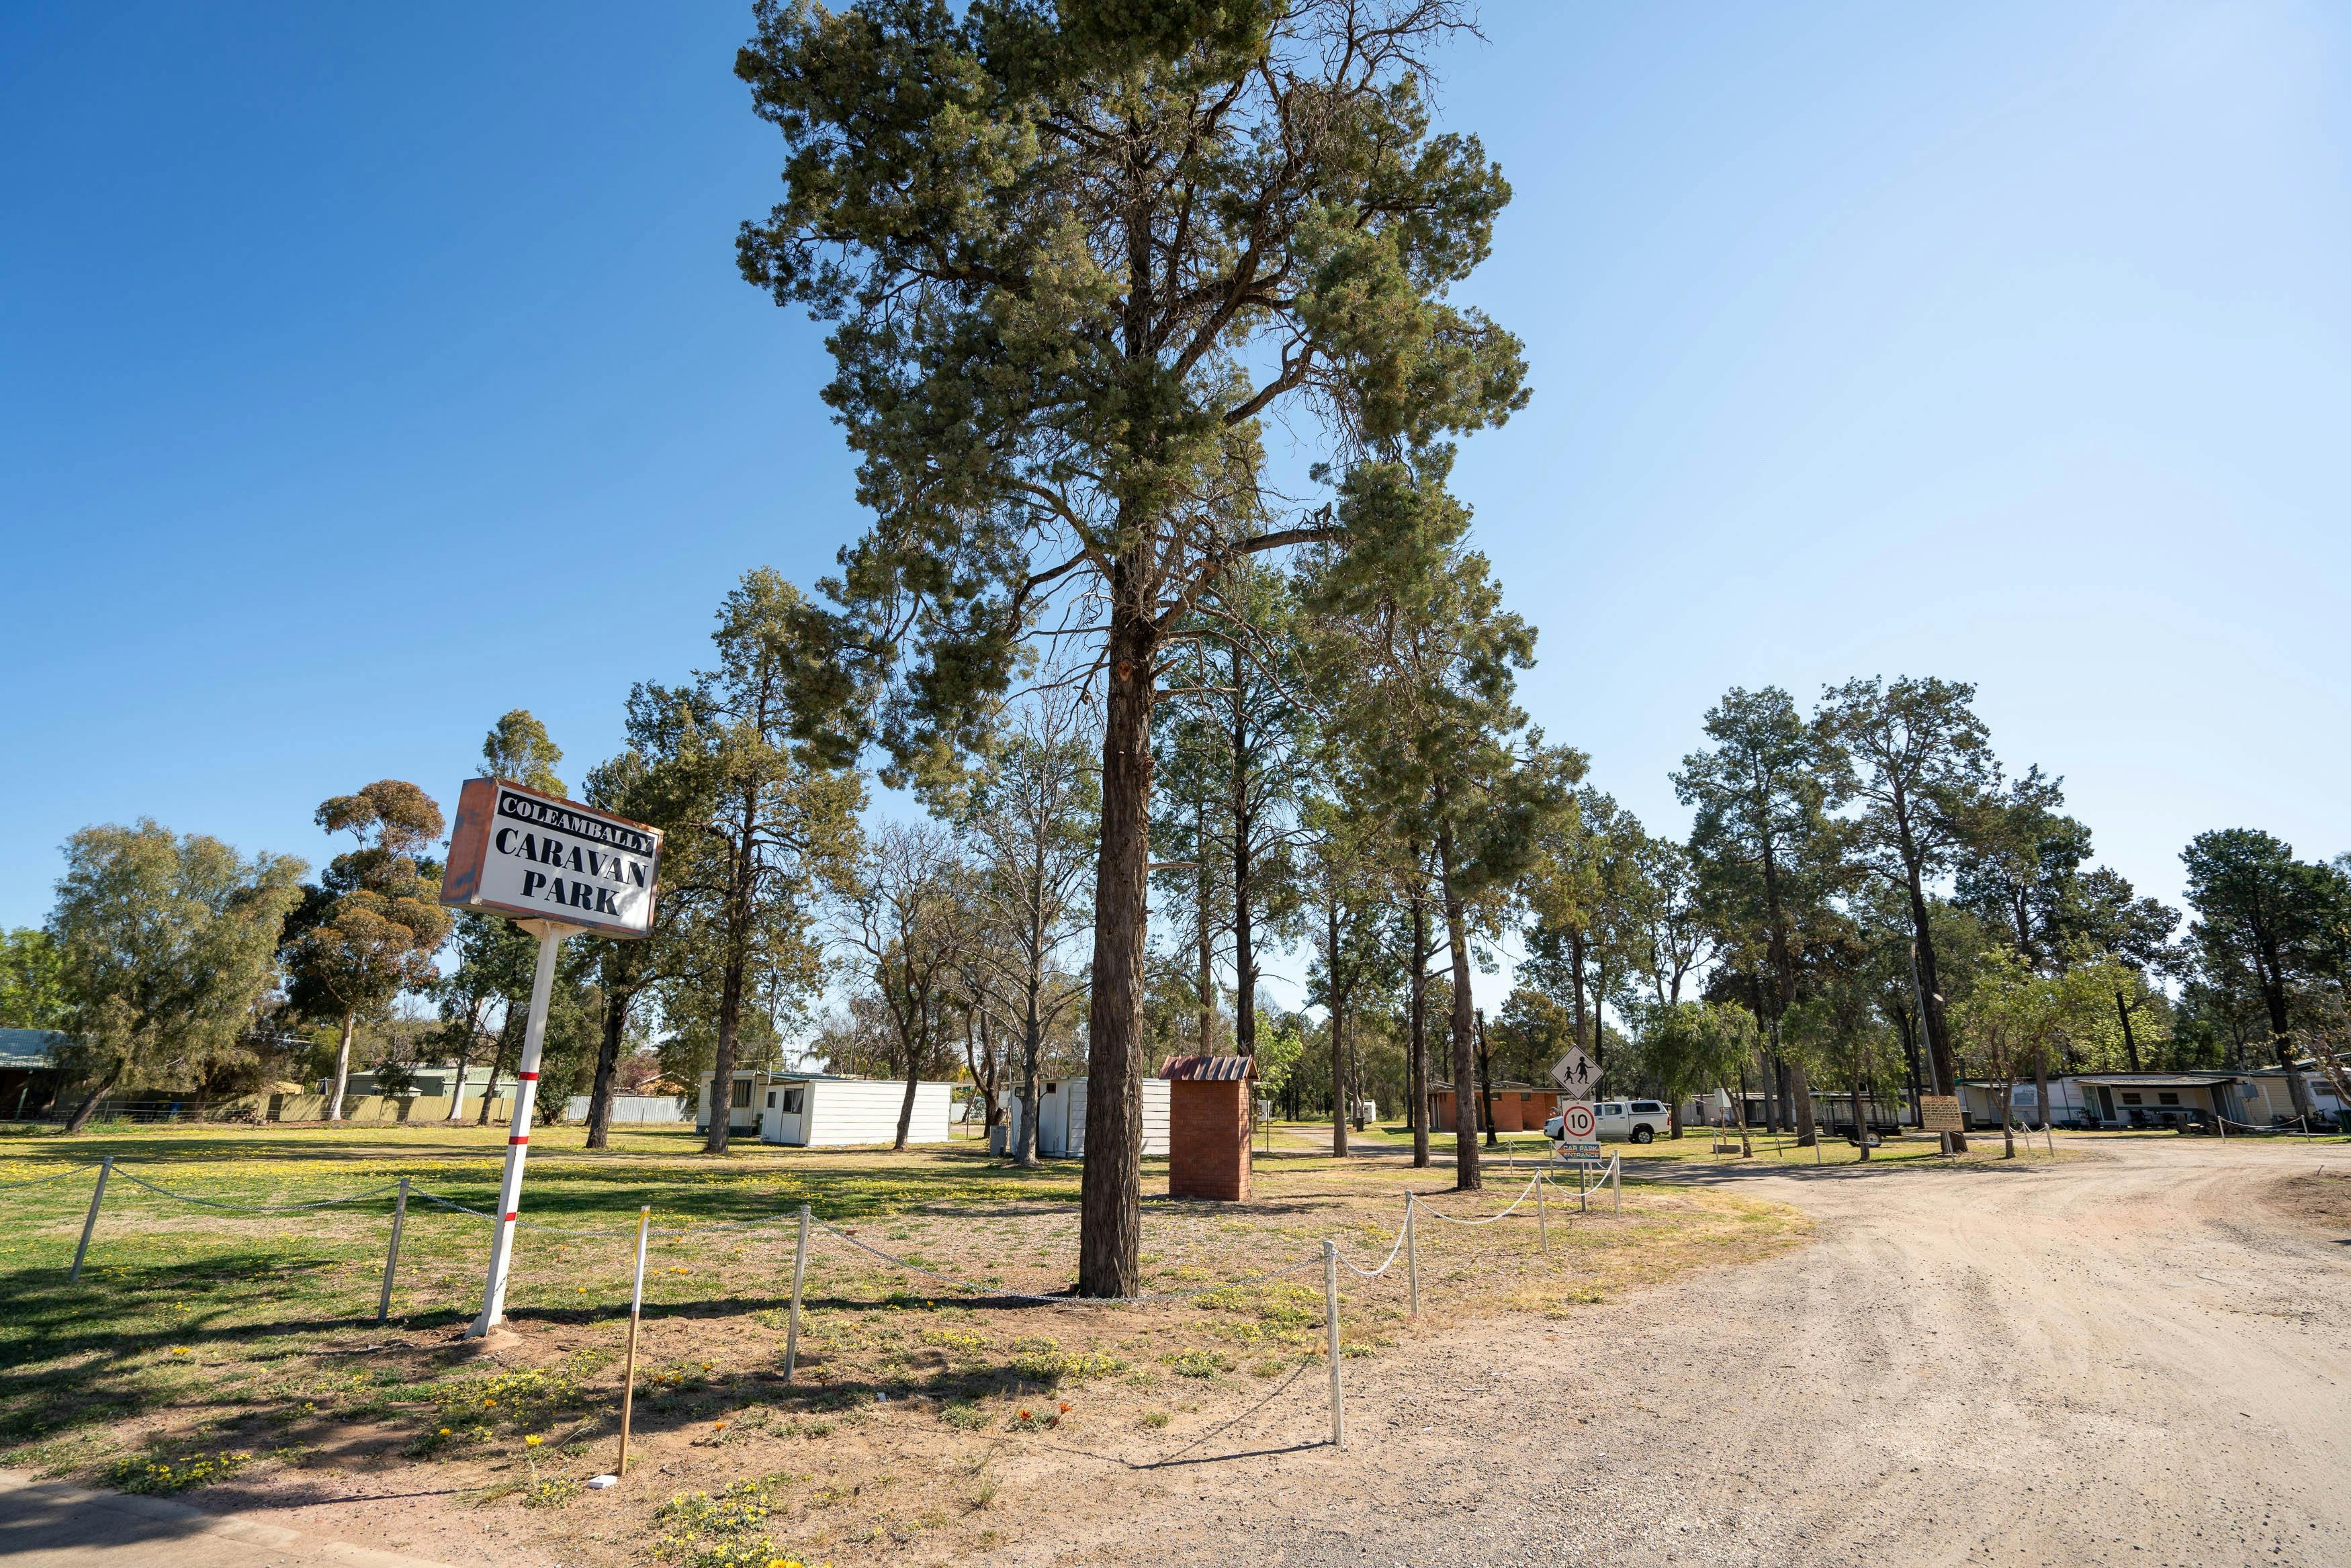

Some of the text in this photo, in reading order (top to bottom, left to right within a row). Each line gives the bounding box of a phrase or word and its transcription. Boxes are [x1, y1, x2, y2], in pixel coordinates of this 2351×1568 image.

[503, 796, 651, 851] COLEAMBALLY
[496, 827, 648, 888] CARAVAN
[521, 870, 619, 916] PARK
[1571, 1114, 1588, 1129] 10
